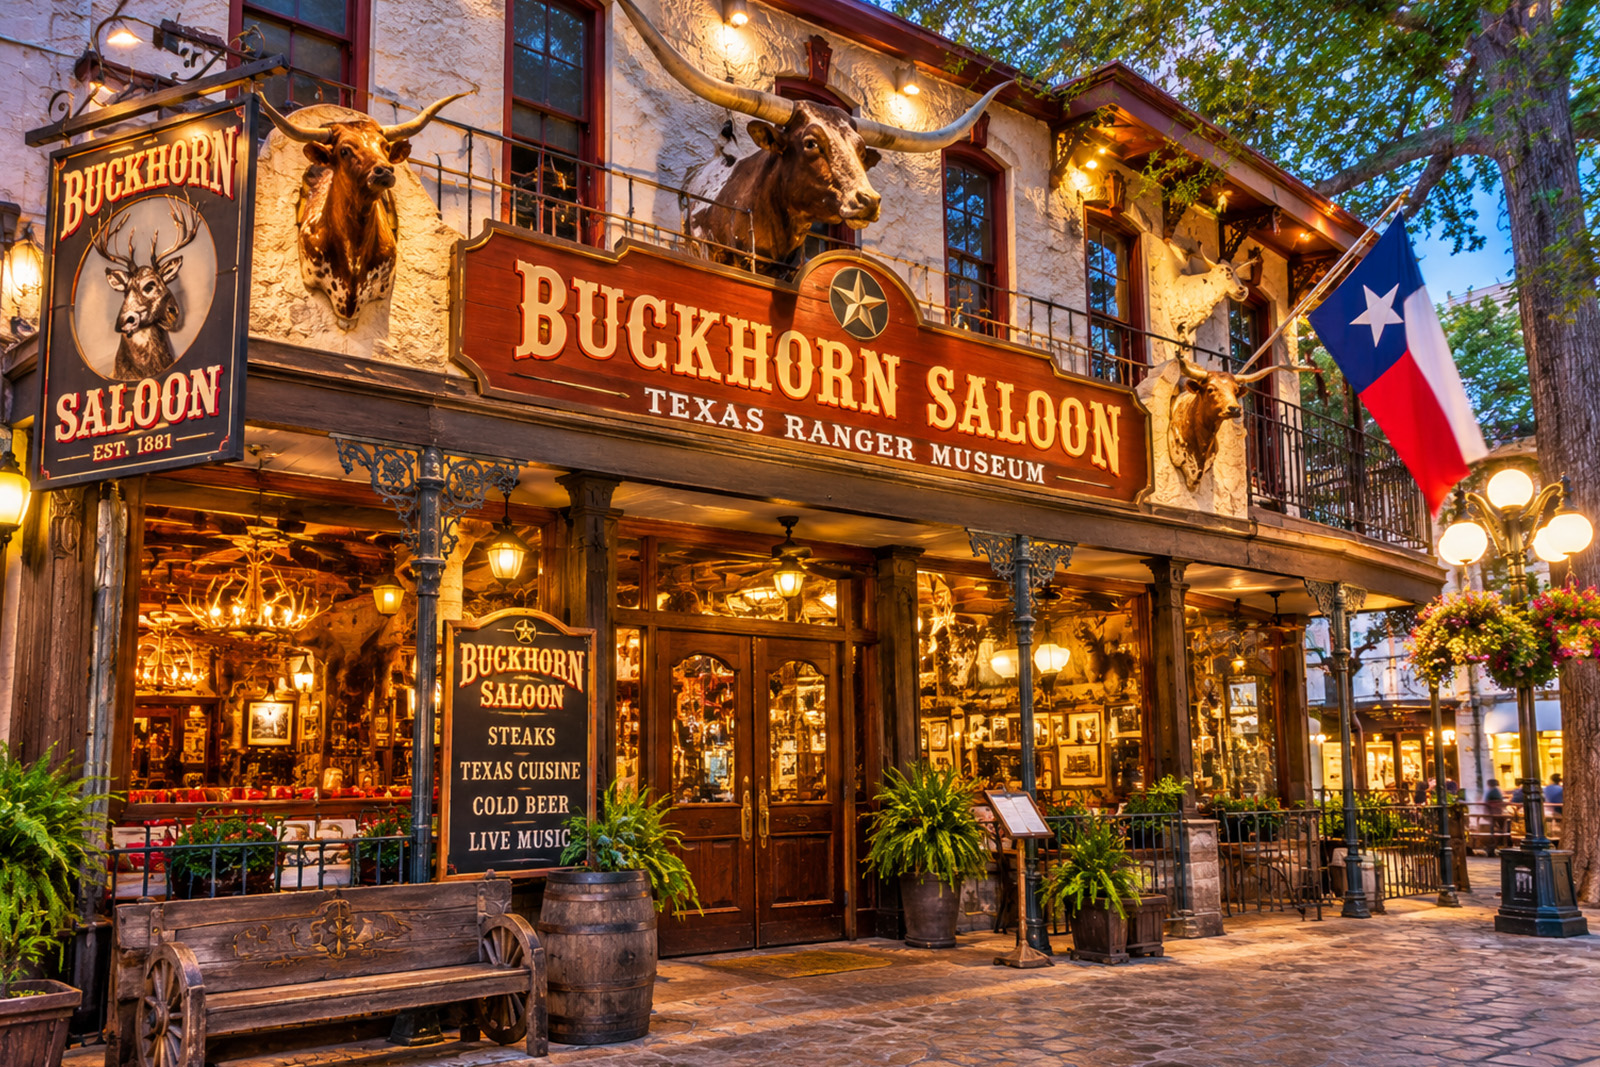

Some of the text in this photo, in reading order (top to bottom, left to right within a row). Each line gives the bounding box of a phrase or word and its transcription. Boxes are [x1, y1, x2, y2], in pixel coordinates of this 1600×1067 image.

[60, 125, 239, 241] BUCKHORN
[514, 259, 1121, 477] BUCKHORN SALOON
[55, 364, 222, 443] SALOON
[92, 432, 173, 462] EST. 1881
[644, 387, 1046, 484] TEXAS RANGER MUSEUM
[459, 642, 586, 693] BUCKHORN
[480, 680, 565, 710] SALOON
[488, 726, 556, 746] STEAKS
[460, 761, 581, 781] TEXAS CUISINE
[472, 795, 569, 816] COLD BEER
[469, 829, 571, 852] LIVE MUSIC
